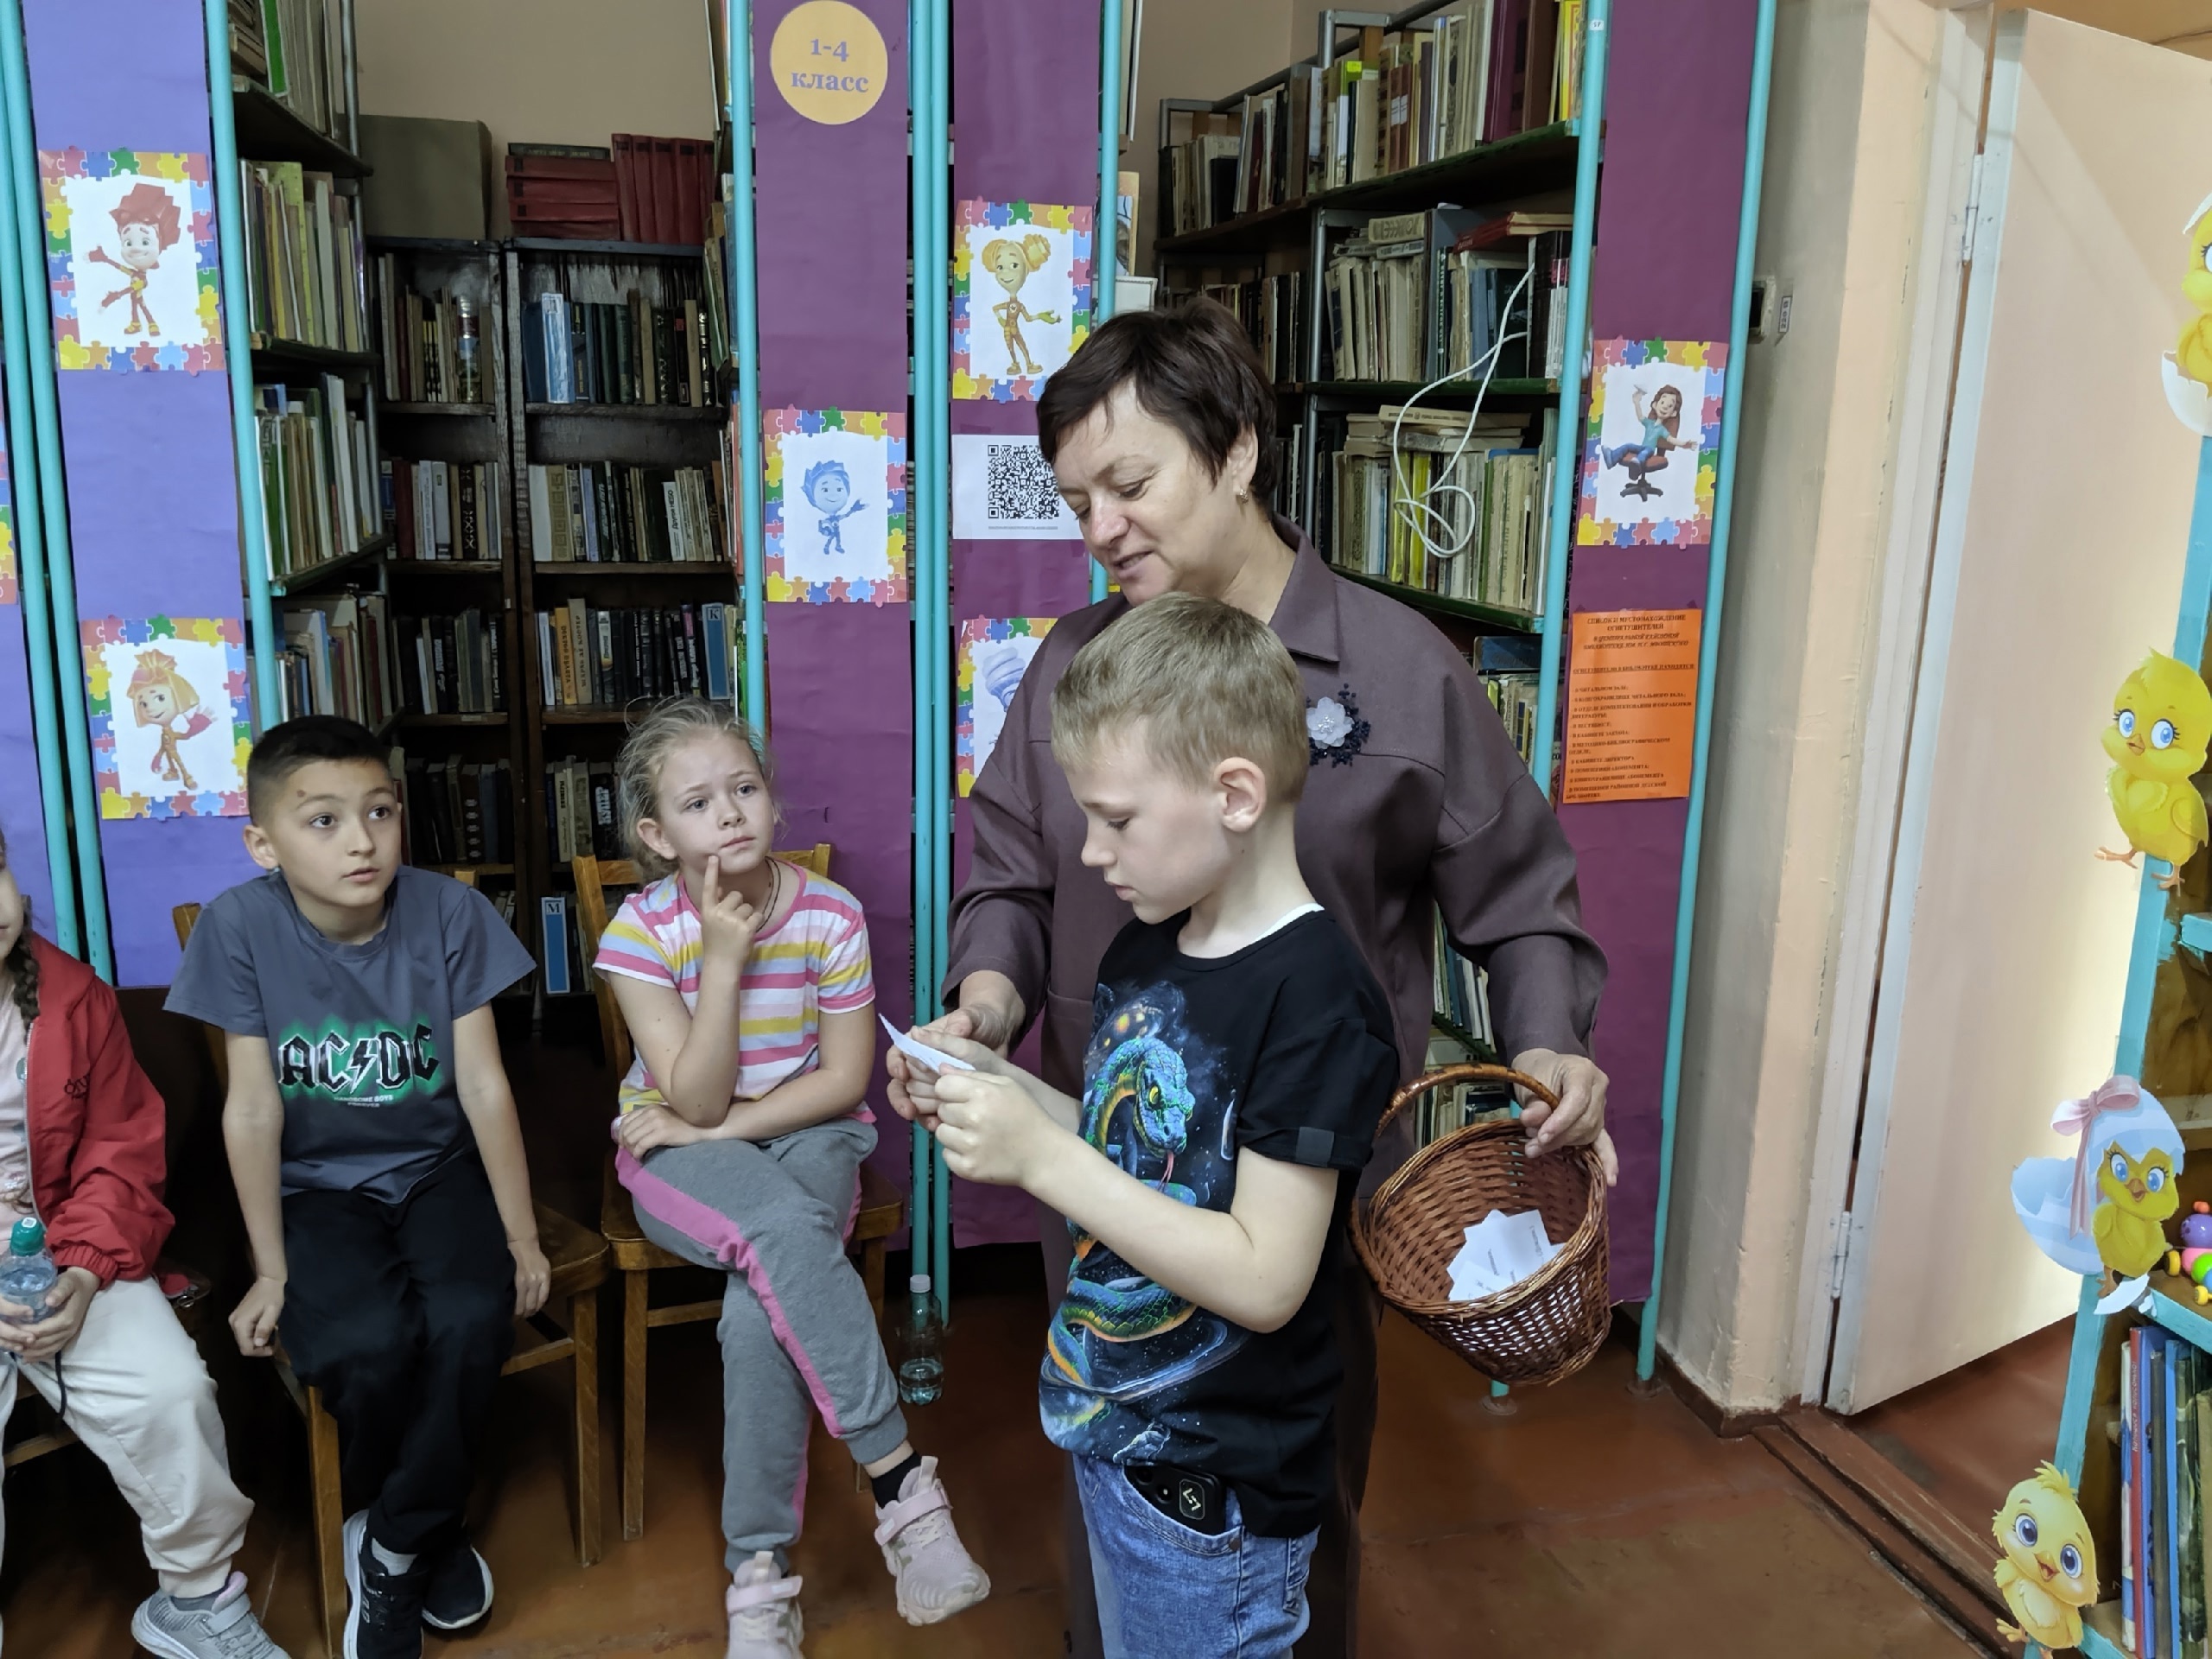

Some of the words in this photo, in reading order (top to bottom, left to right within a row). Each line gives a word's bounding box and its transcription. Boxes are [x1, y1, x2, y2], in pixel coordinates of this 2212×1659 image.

[810, 38, 849, 62] 1-4
[791, 73, 869, 93] класс
[547, 902, 560, 912] М
